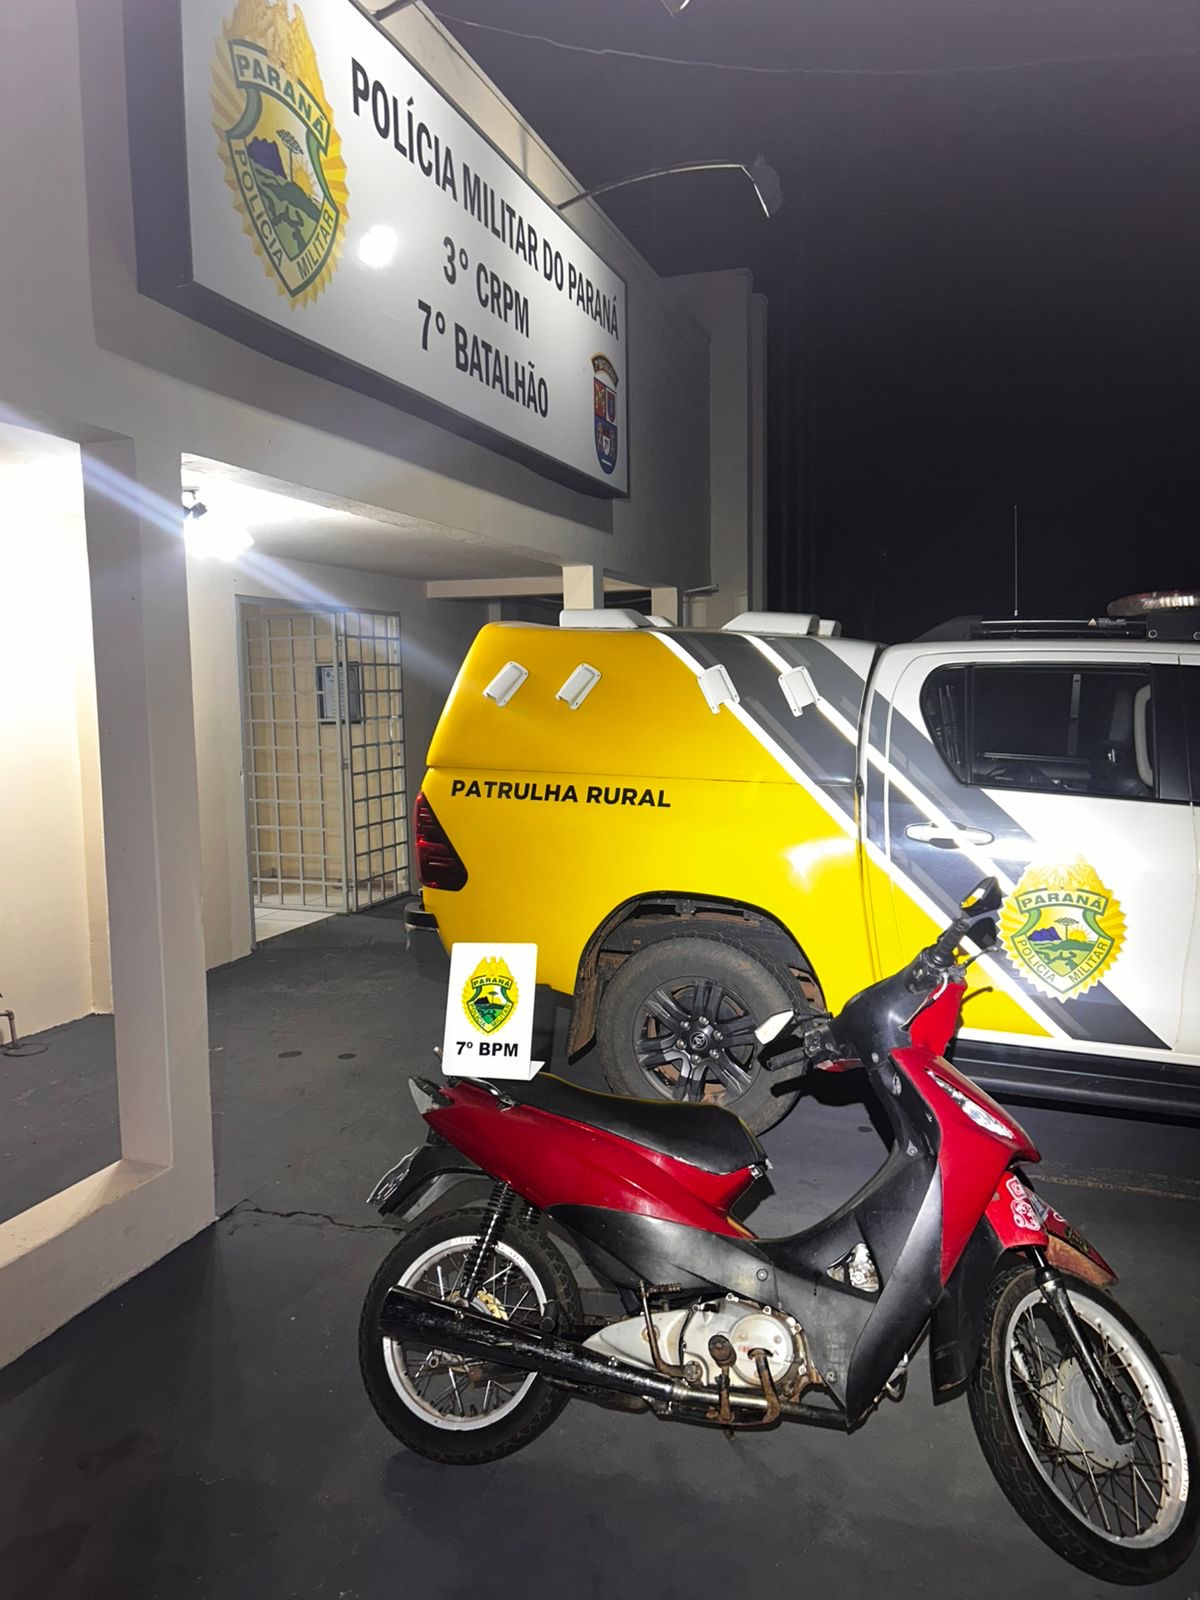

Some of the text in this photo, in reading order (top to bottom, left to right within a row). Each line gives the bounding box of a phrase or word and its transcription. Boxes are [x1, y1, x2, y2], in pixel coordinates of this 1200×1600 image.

[236, 54, 326, 141] PARANÁ
[352, 56, 619, 340] POLÍCIA MILITAR DO PARANÁ
[296, 212, 334, 280] MILITAR
[443, 236, 530, 338] 3º CRPM
[418, 299, 446, 350] 7º
[454, 322, 549, 418] BATALHÃO
[451, 779, 671, 808] PATRULHA RURAL
[1021, 893, 1103, 910] PARANÁ
[1068, 941, 1108, 983] MILITAR
[456, 1041, 518, 1057] 7º BPM
